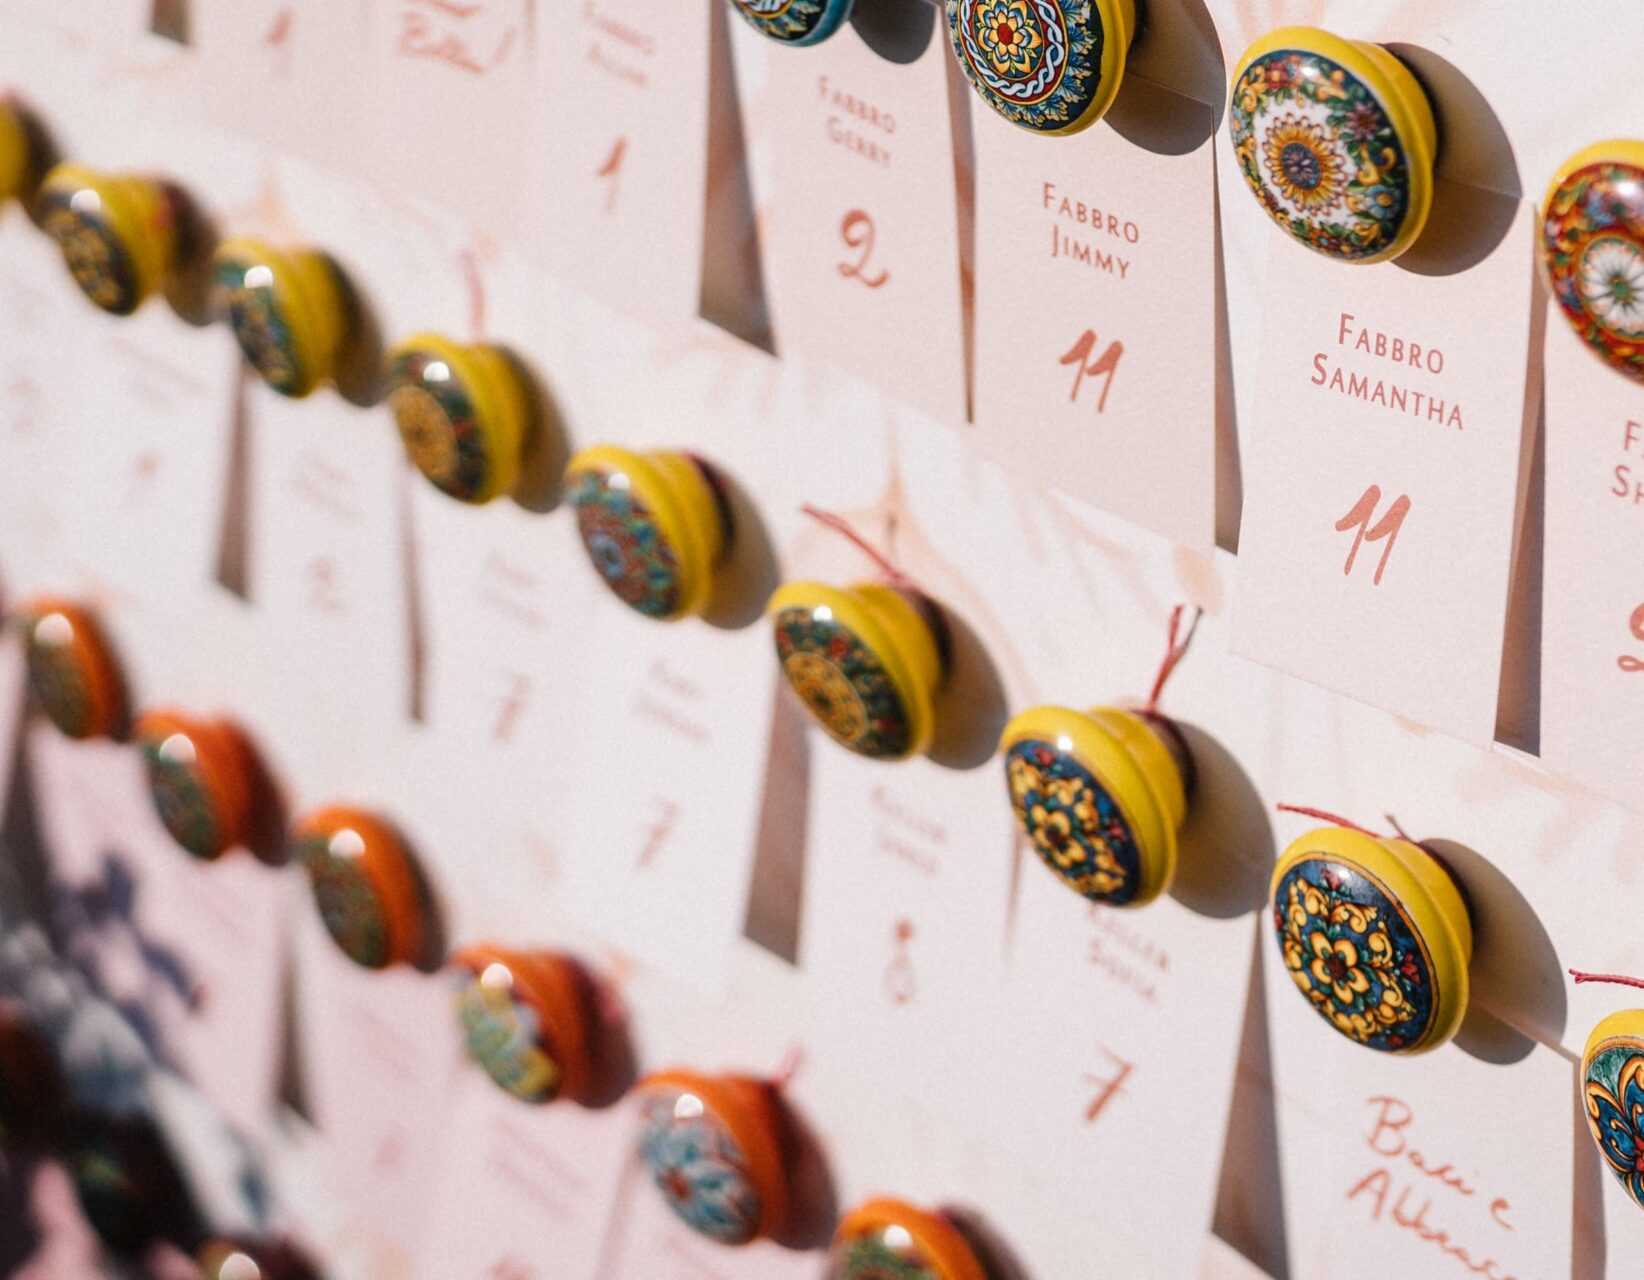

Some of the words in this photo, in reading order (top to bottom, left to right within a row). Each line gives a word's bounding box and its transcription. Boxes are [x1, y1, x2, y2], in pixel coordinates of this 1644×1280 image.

[819, 76, 895, 135] FABBRO
[837, 208, 890, 288] 2
[1042, 182, 1140, 244] FABBRO
[1051, 225, 1131, 280] JIMMY
[1059, 329, 1124, 413] 11
[1338, 312, 1445, 375] FABBRO
[1311, 352, 1463, 430] SAMANTHA
[1334, 484, 1412, 586] 11
[1082, 1045, 1132, 1122] 7
